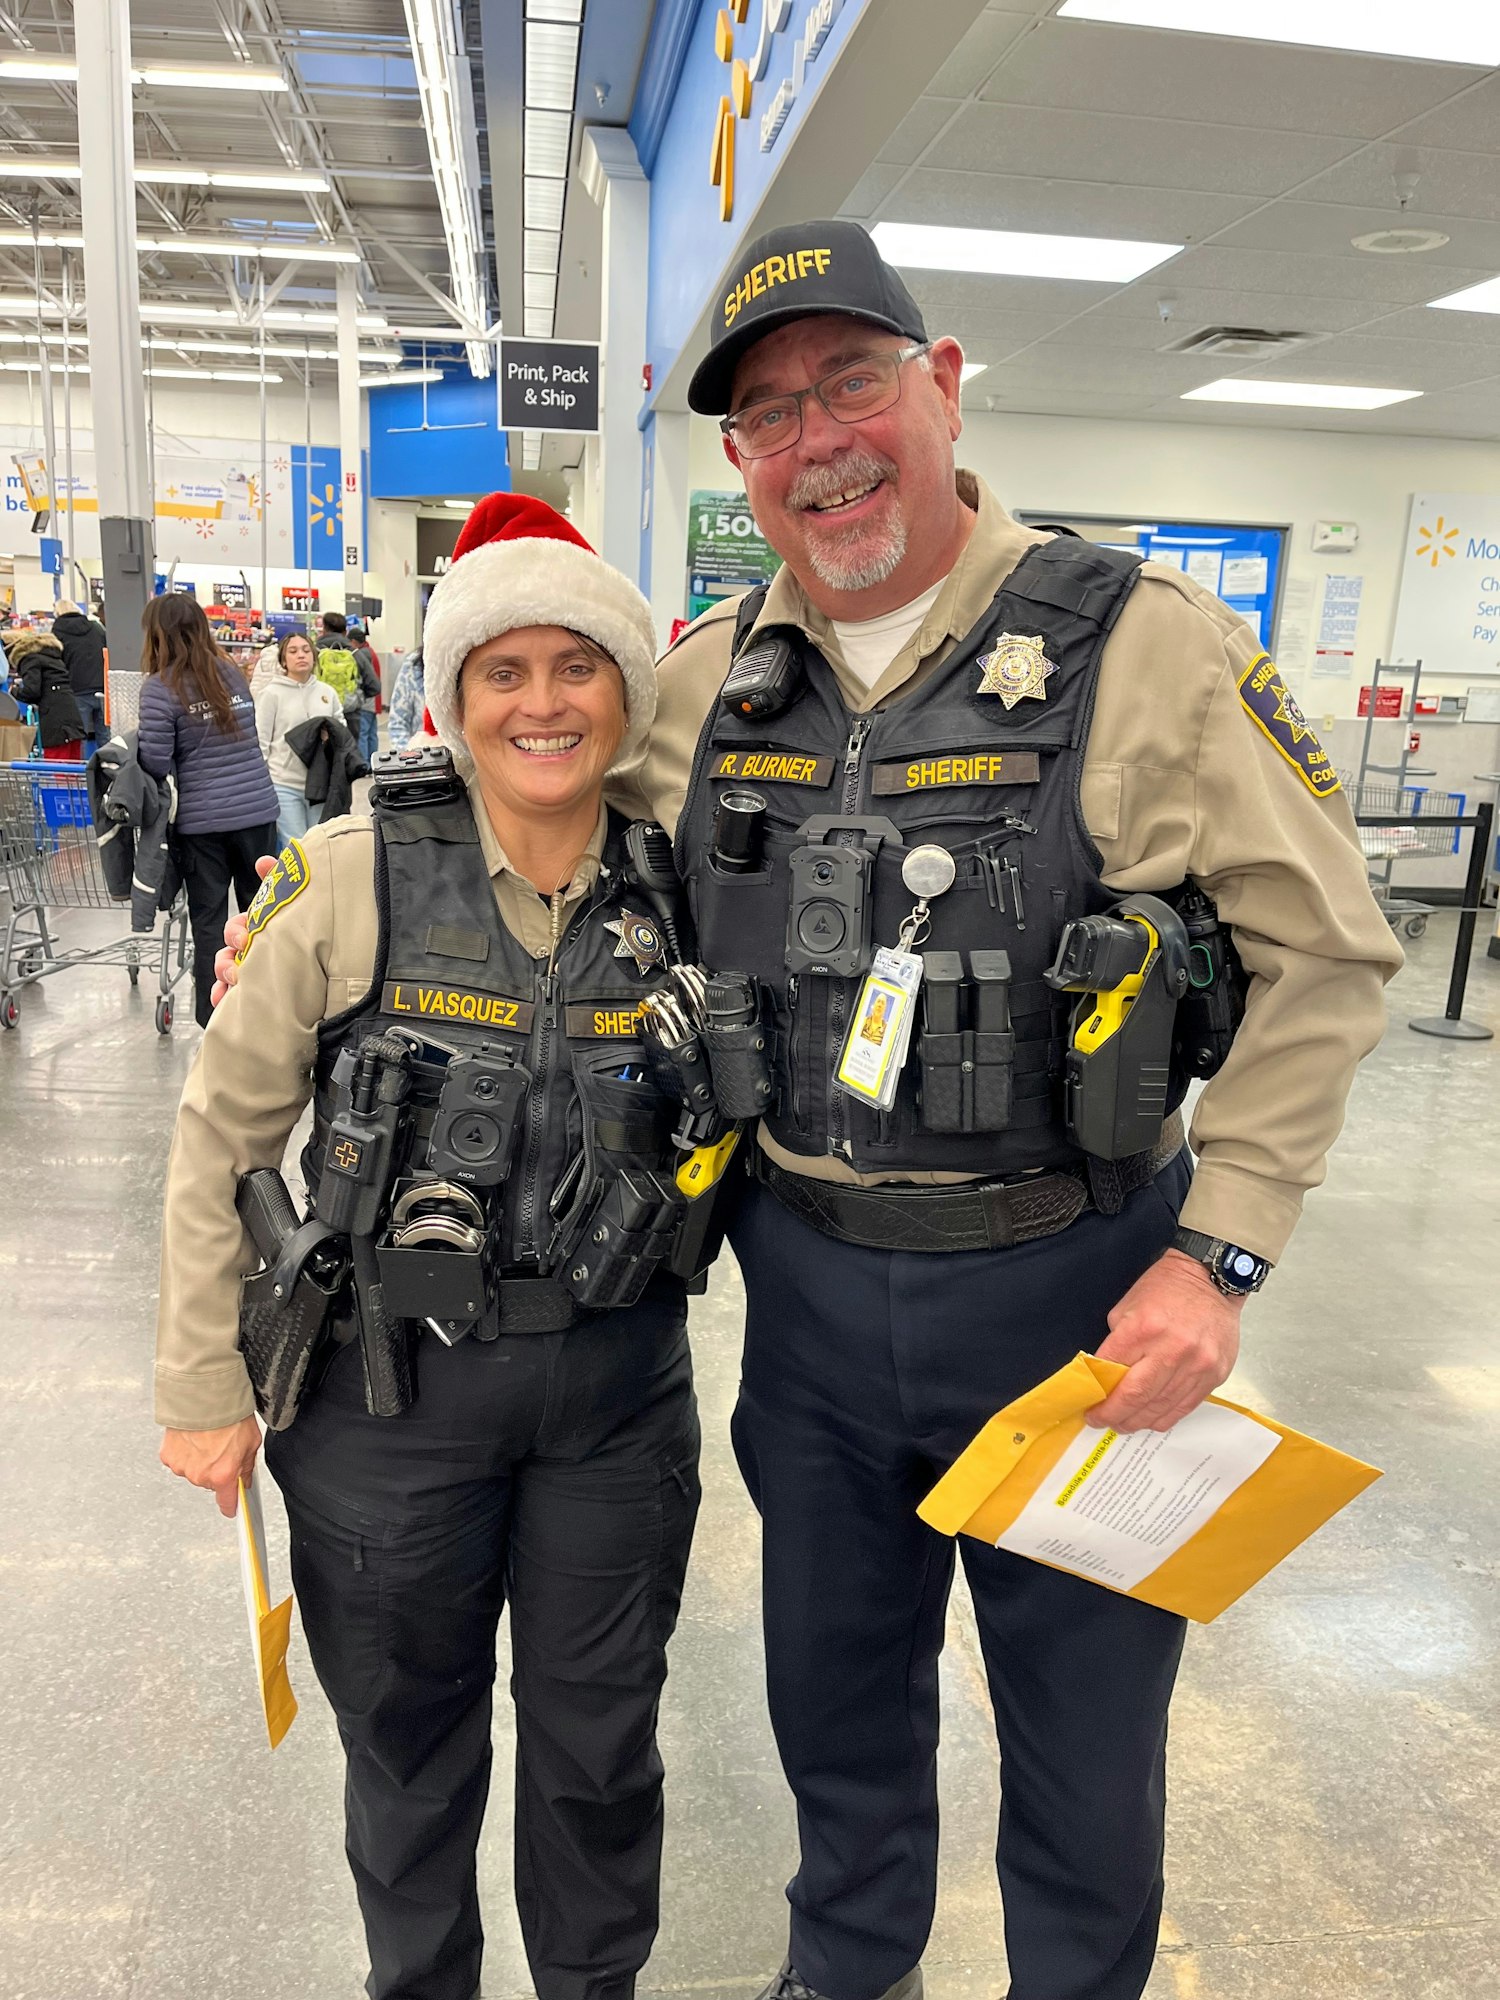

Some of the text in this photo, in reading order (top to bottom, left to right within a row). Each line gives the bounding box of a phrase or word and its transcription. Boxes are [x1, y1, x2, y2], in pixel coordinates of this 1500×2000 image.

[725, 249, 831, 327] SHERIFF
[507, 362, 589, 384] Print, Pack
[524, 388, 576, 411] & Ship
[1466, 538, 1500, 559] Mo
[1473, 625, 1497, 644] Pay
[720, 754, 817, 781] R. BURNER
[1307, 750, 1328, 765] EAG
[906, 757, 1002, 787] SHERIFF
[1311, 765, 1337, 784] COU
[394, 986, 519, 1027] L. VASQUEZ
[457, 1171, 475, 1180] AXON
[1057, 1477, 1083, 1506] Schedule
[1081, 1467, 1089, 1477] of
